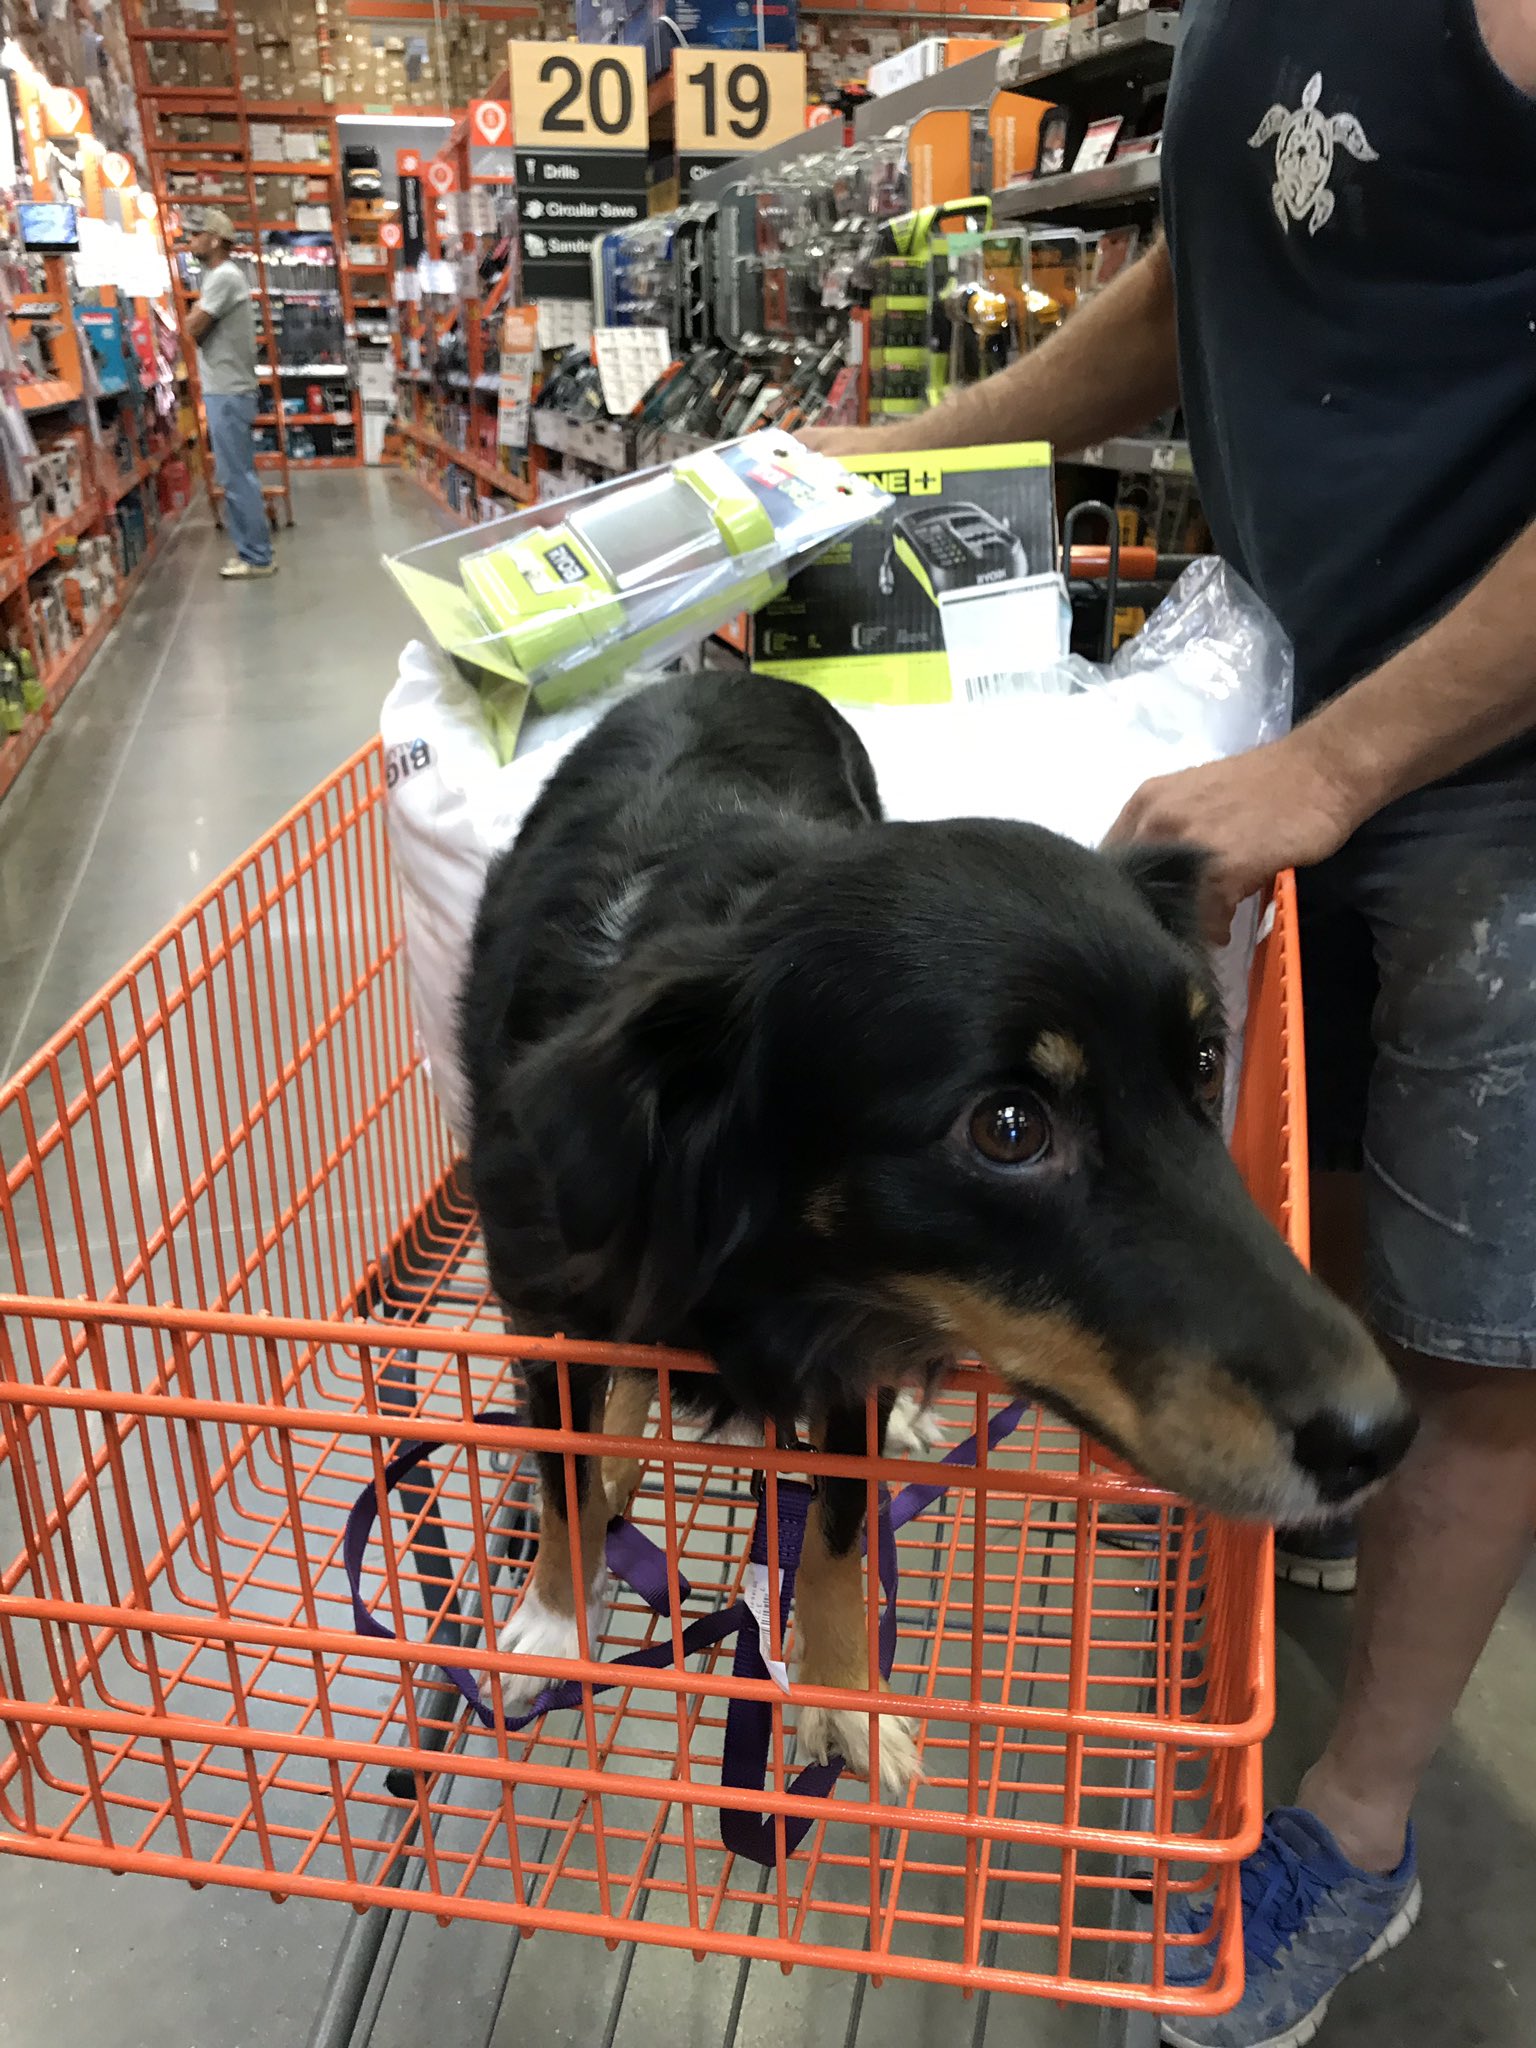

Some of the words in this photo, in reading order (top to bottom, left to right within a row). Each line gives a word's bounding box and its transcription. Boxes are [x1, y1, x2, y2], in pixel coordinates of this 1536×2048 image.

[539, 55, 632, 135] 20
[688, 62, 769, 139] 19
[543, 164, 580, 180] Drills
[546, 201, 598, 217] Circular
[600, 201, 638, 218] Saws
